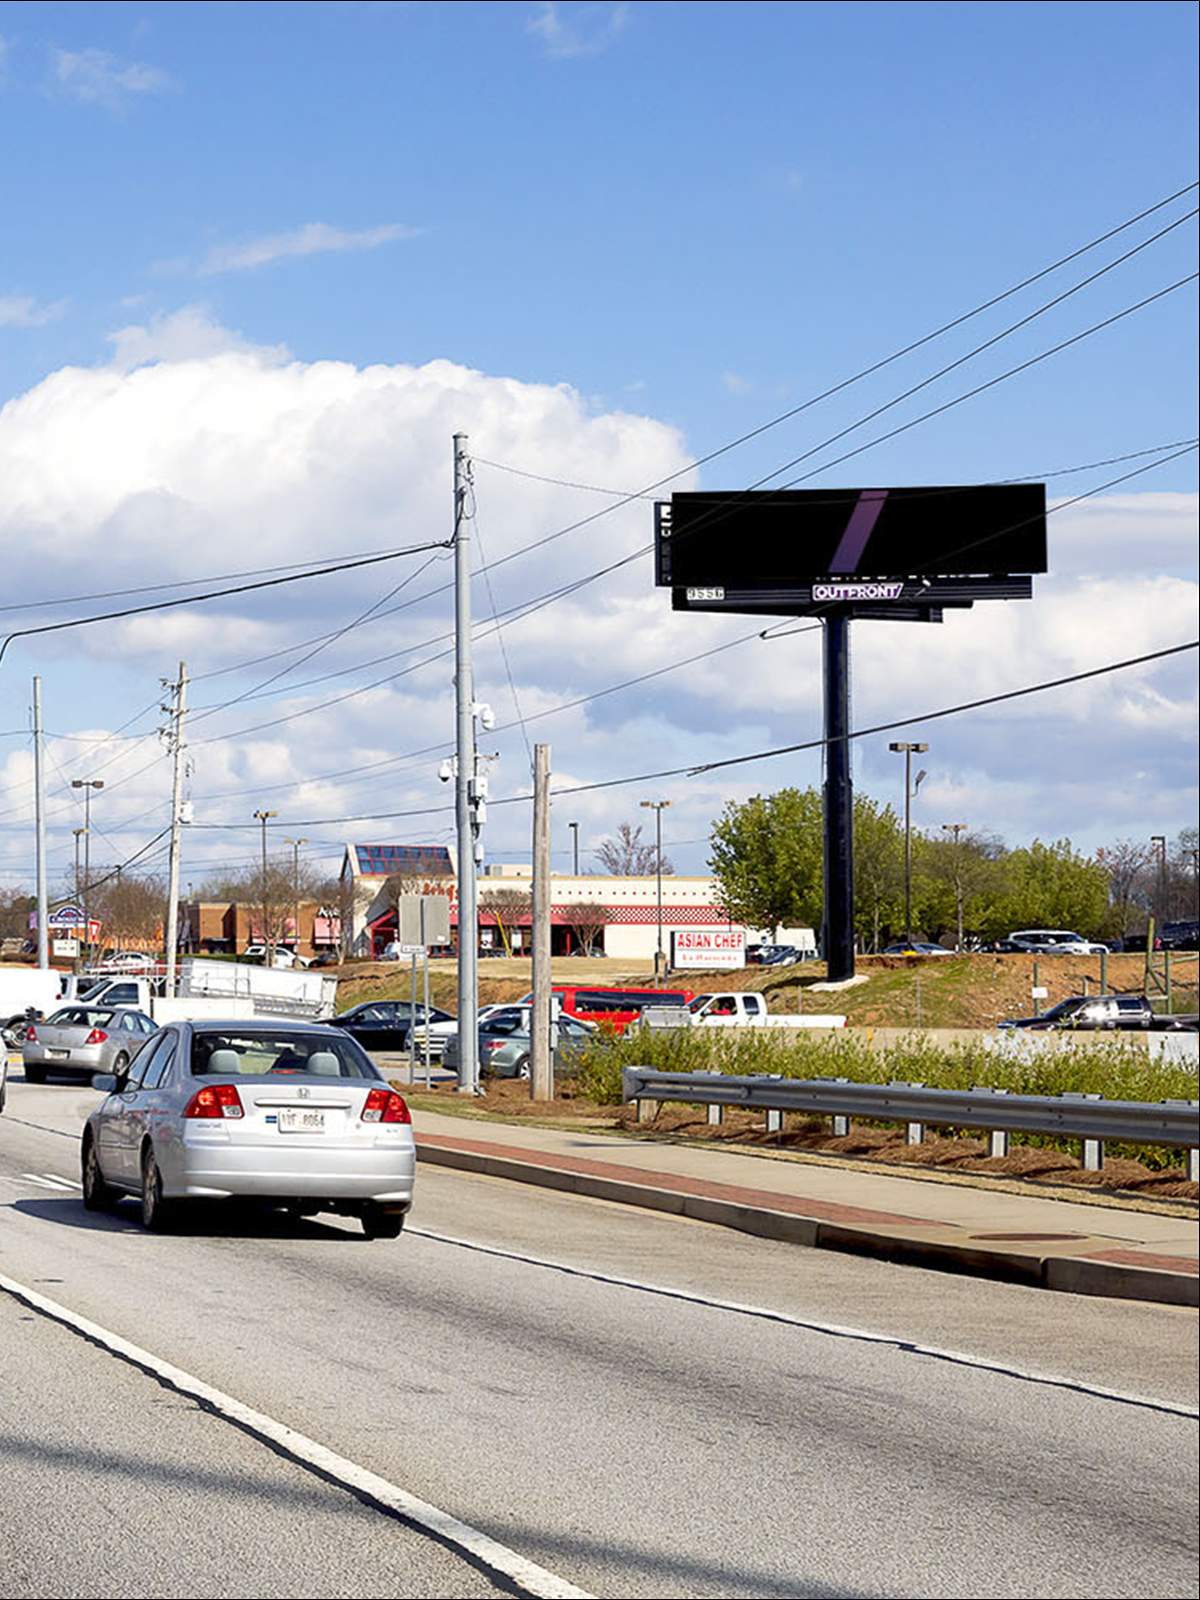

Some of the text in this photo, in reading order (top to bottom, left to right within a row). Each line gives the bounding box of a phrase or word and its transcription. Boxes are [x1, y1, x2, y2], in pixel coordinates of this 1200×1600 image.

[814, 583, 899, 600] OUTFRONT
[677, 933, 743, 948] ASIAN CHEF
